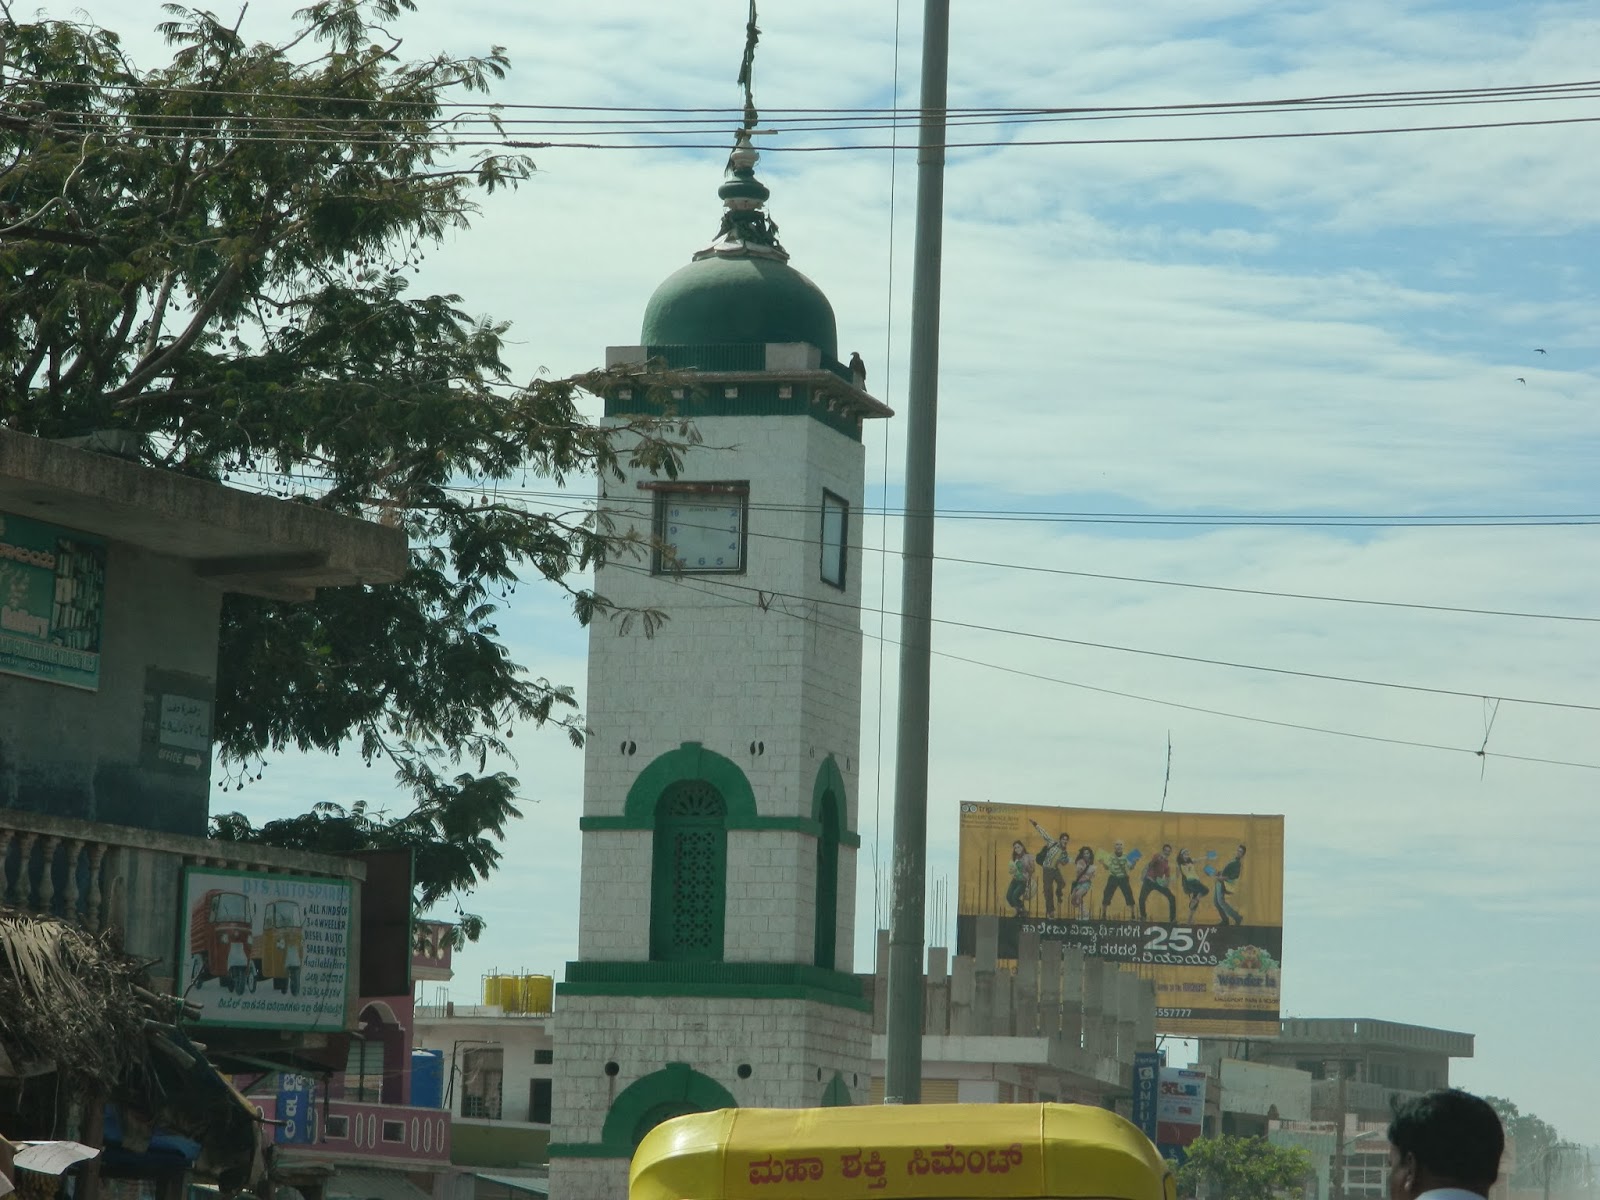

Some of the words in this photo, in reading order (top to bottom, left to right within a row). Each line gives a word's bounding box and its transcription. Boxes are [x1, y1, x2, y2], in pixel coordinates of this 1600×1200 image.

[309, 904, 320, 915] ALL
[325, 932, 343, 944] AUTO
[306, 944, 324, 955] SPARE
[326, 946, 346, 957] PARTS
[749, 1154, 824, 1184] ಮಹಾ
[841, 1147, 888, 1189] ಶಕ್ತಿ
[908, 1143, 1022, 1177] ಸಿಮೆಂಟ್
